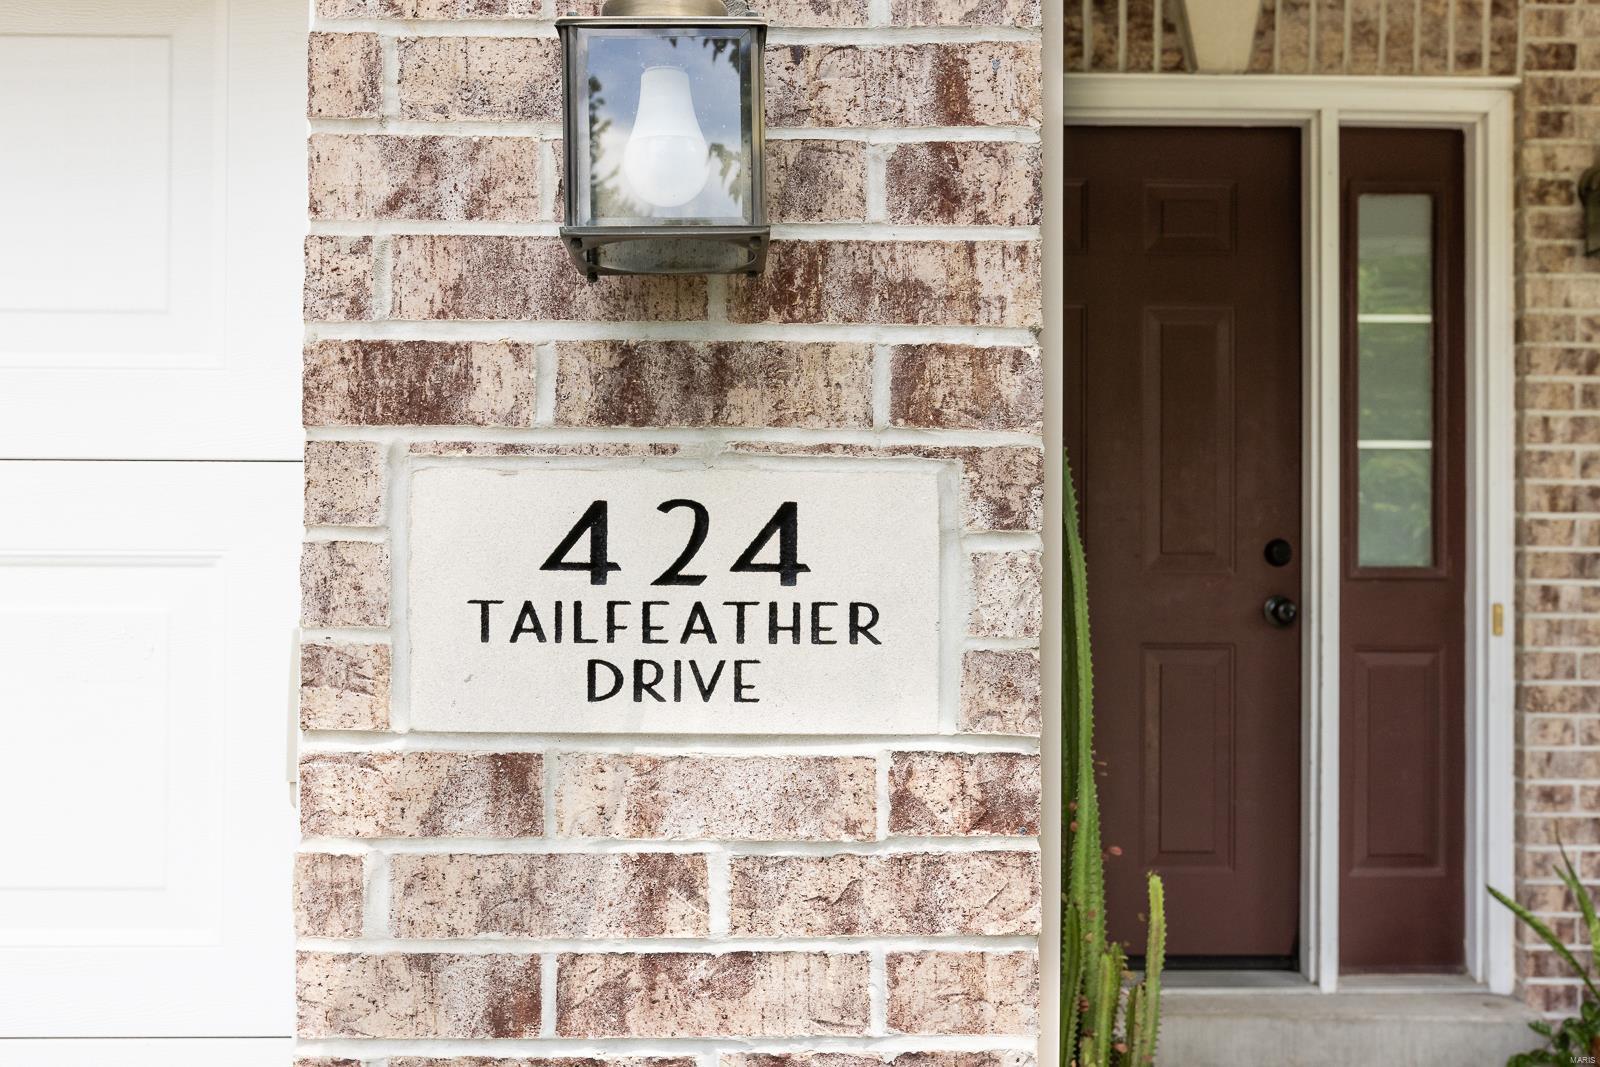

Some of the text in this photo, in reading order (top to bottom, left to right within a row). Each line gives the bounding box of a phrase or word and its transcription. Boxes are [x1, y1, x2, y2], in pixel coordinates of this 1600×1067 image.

[539, 498, 812, 587] 424
[467, 599, 882, 646] TAILFEATHER
[586, 658, 761, 703] DRIVE
